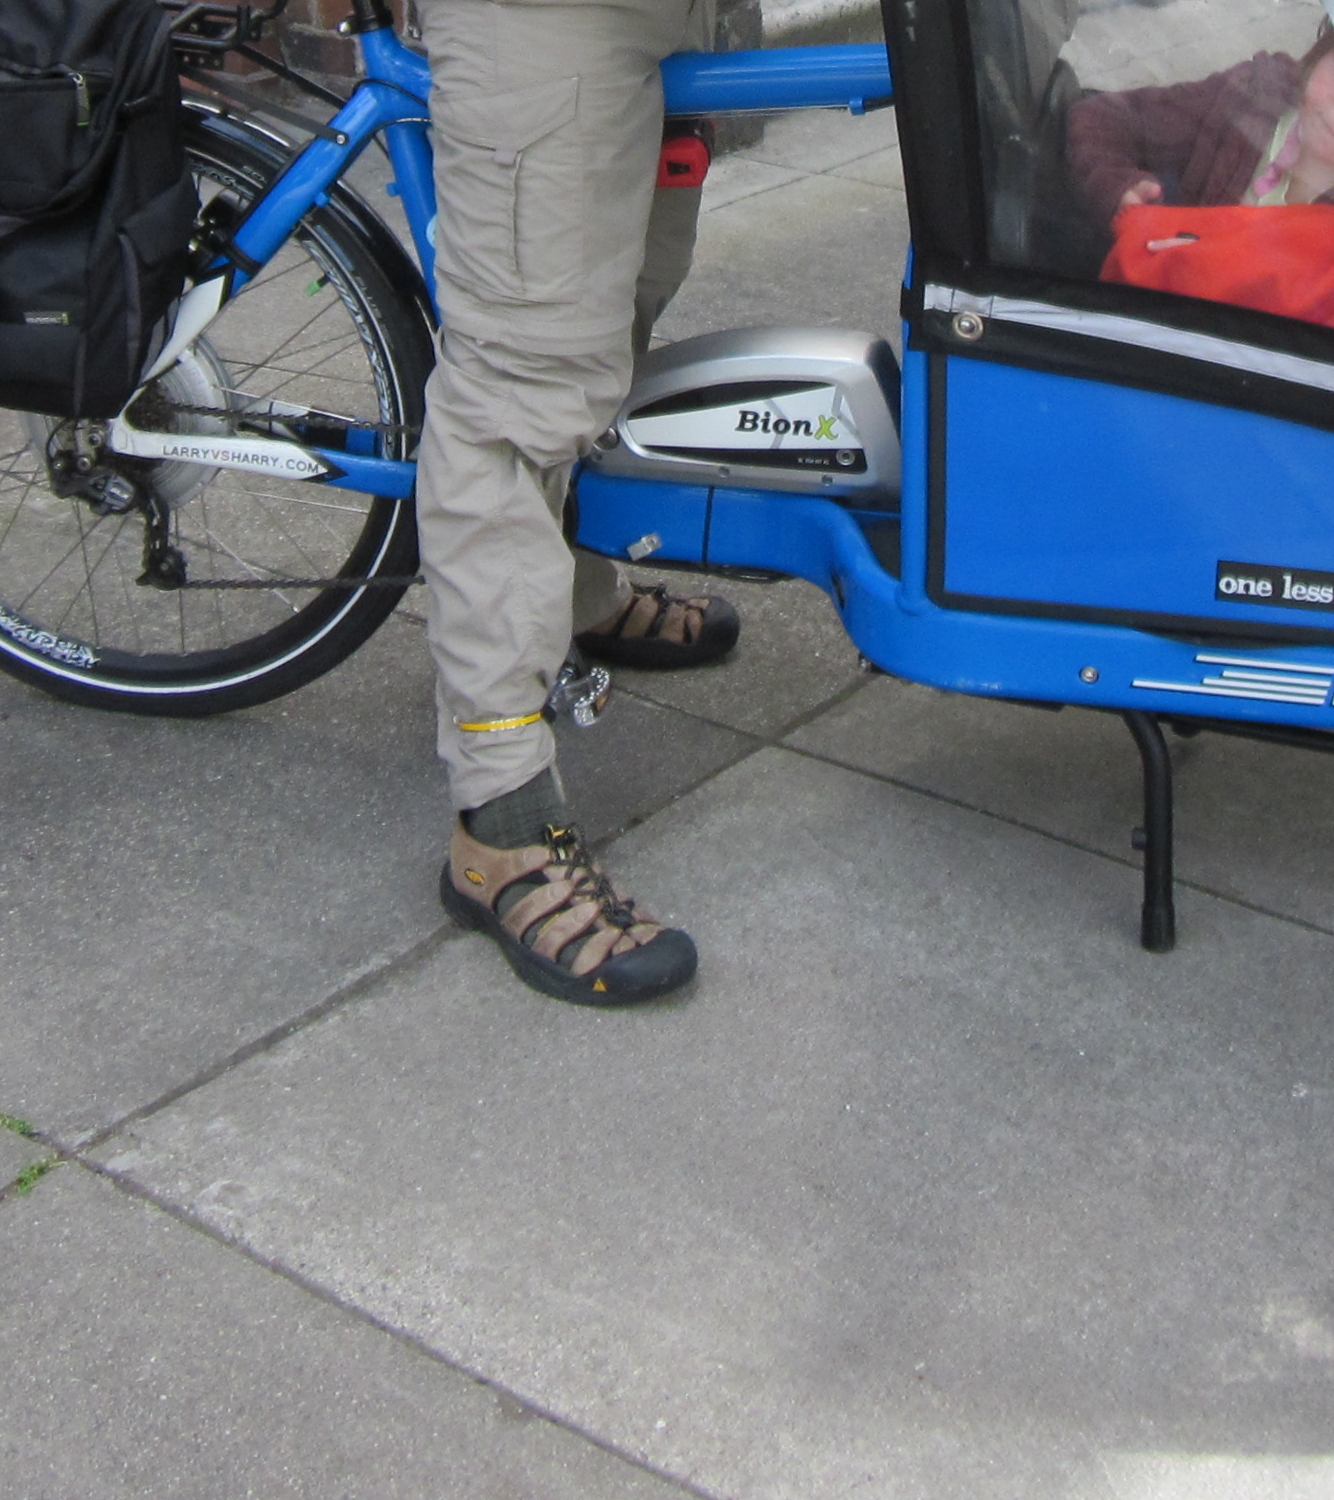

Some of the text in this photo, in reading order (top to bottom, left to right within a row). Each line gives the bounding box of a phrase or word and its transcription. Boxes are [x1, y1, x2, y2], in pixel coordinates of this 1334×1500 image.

[734, 409, 839, 441] BionX
[162, 444, 318, 474] LARRYVSHARRY.COM
[1218, 573, 1273, 599] one
[1282, 570, 1334, 605] less
